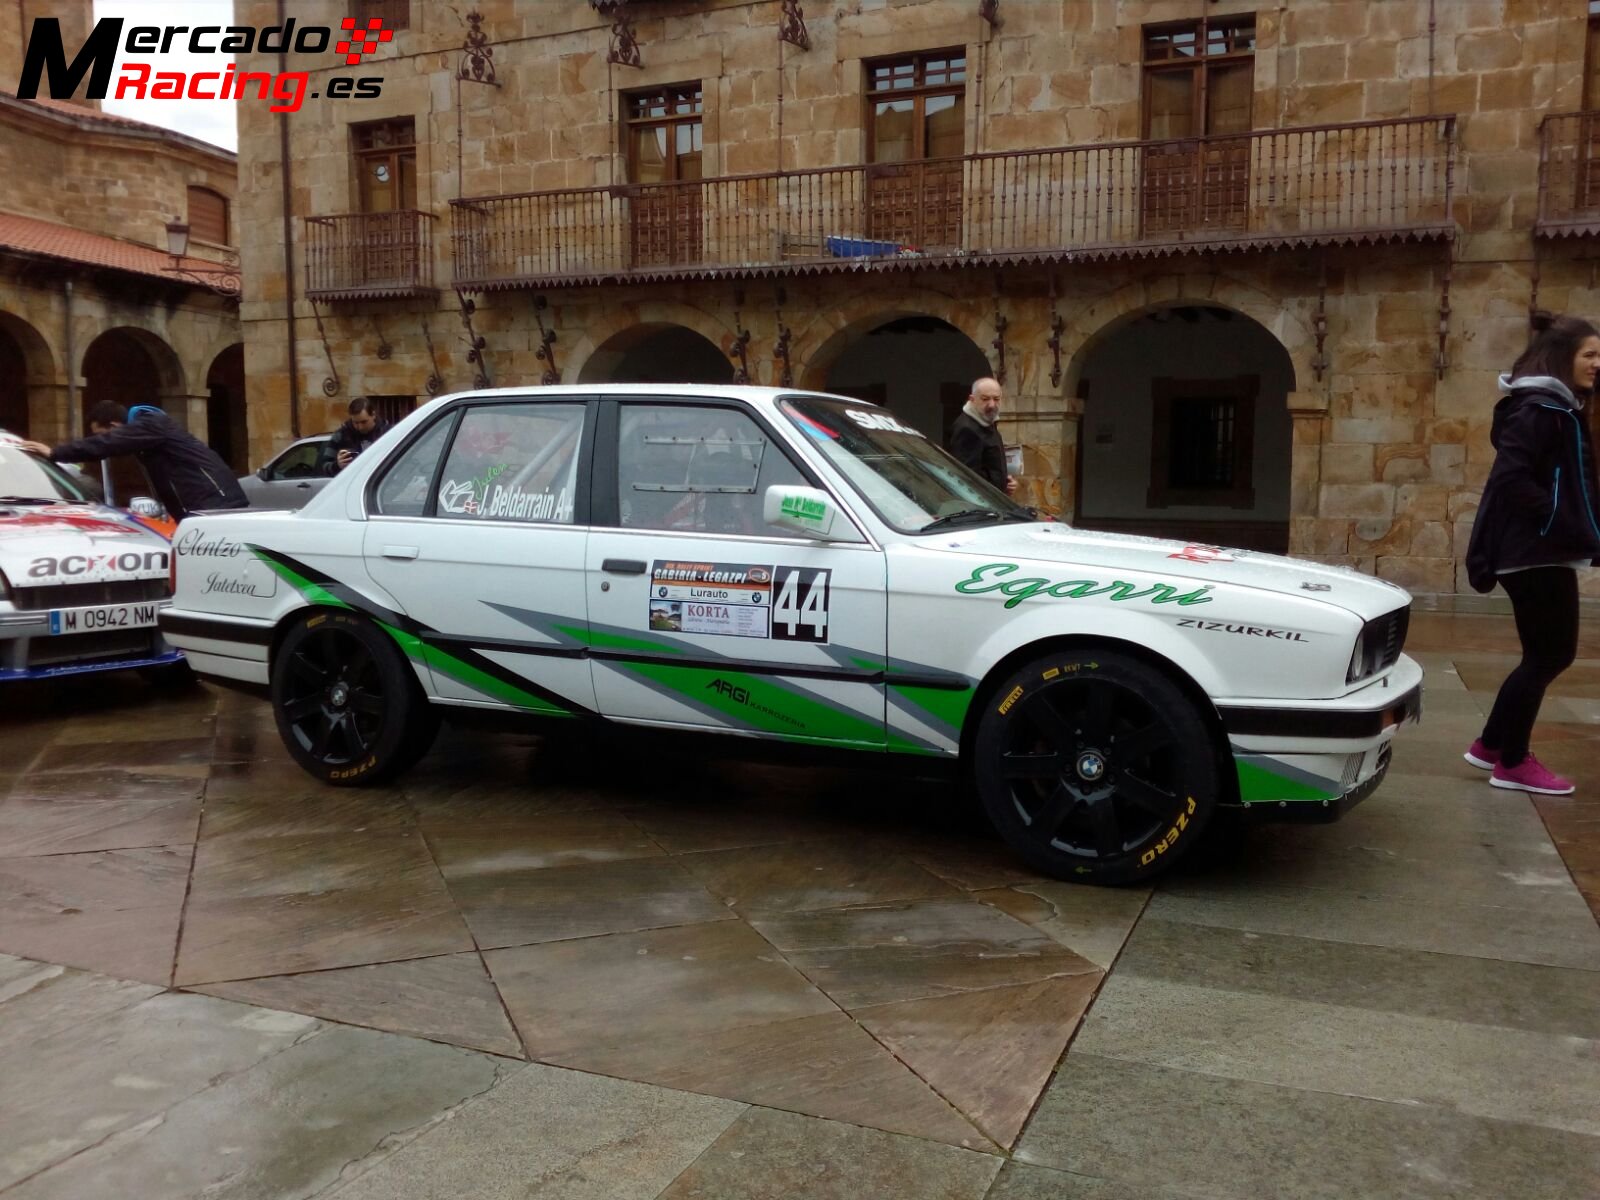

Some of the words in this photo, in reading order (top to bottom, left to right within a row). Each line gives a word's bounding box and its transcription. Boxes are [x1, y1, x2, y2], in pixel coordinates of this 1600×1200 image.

[489, 484, 555, 519] Beldarrain
[703, 571, 747, 584] LEGAZPI
[954, 562, 1214, 609] Egarri
[690, 588, 729, 599] Lurauto
[773, 570, 828, 638] 44
[65, 611, 77, 630] M
[84, 608, 128, 628] 0942
[133, 605, 155, 624] NM
[687, 604, 730, 619] KORTA
[1176, 618, 1310, 643] ZIZURKIL
[705, 678, 750, 705] ARGI
